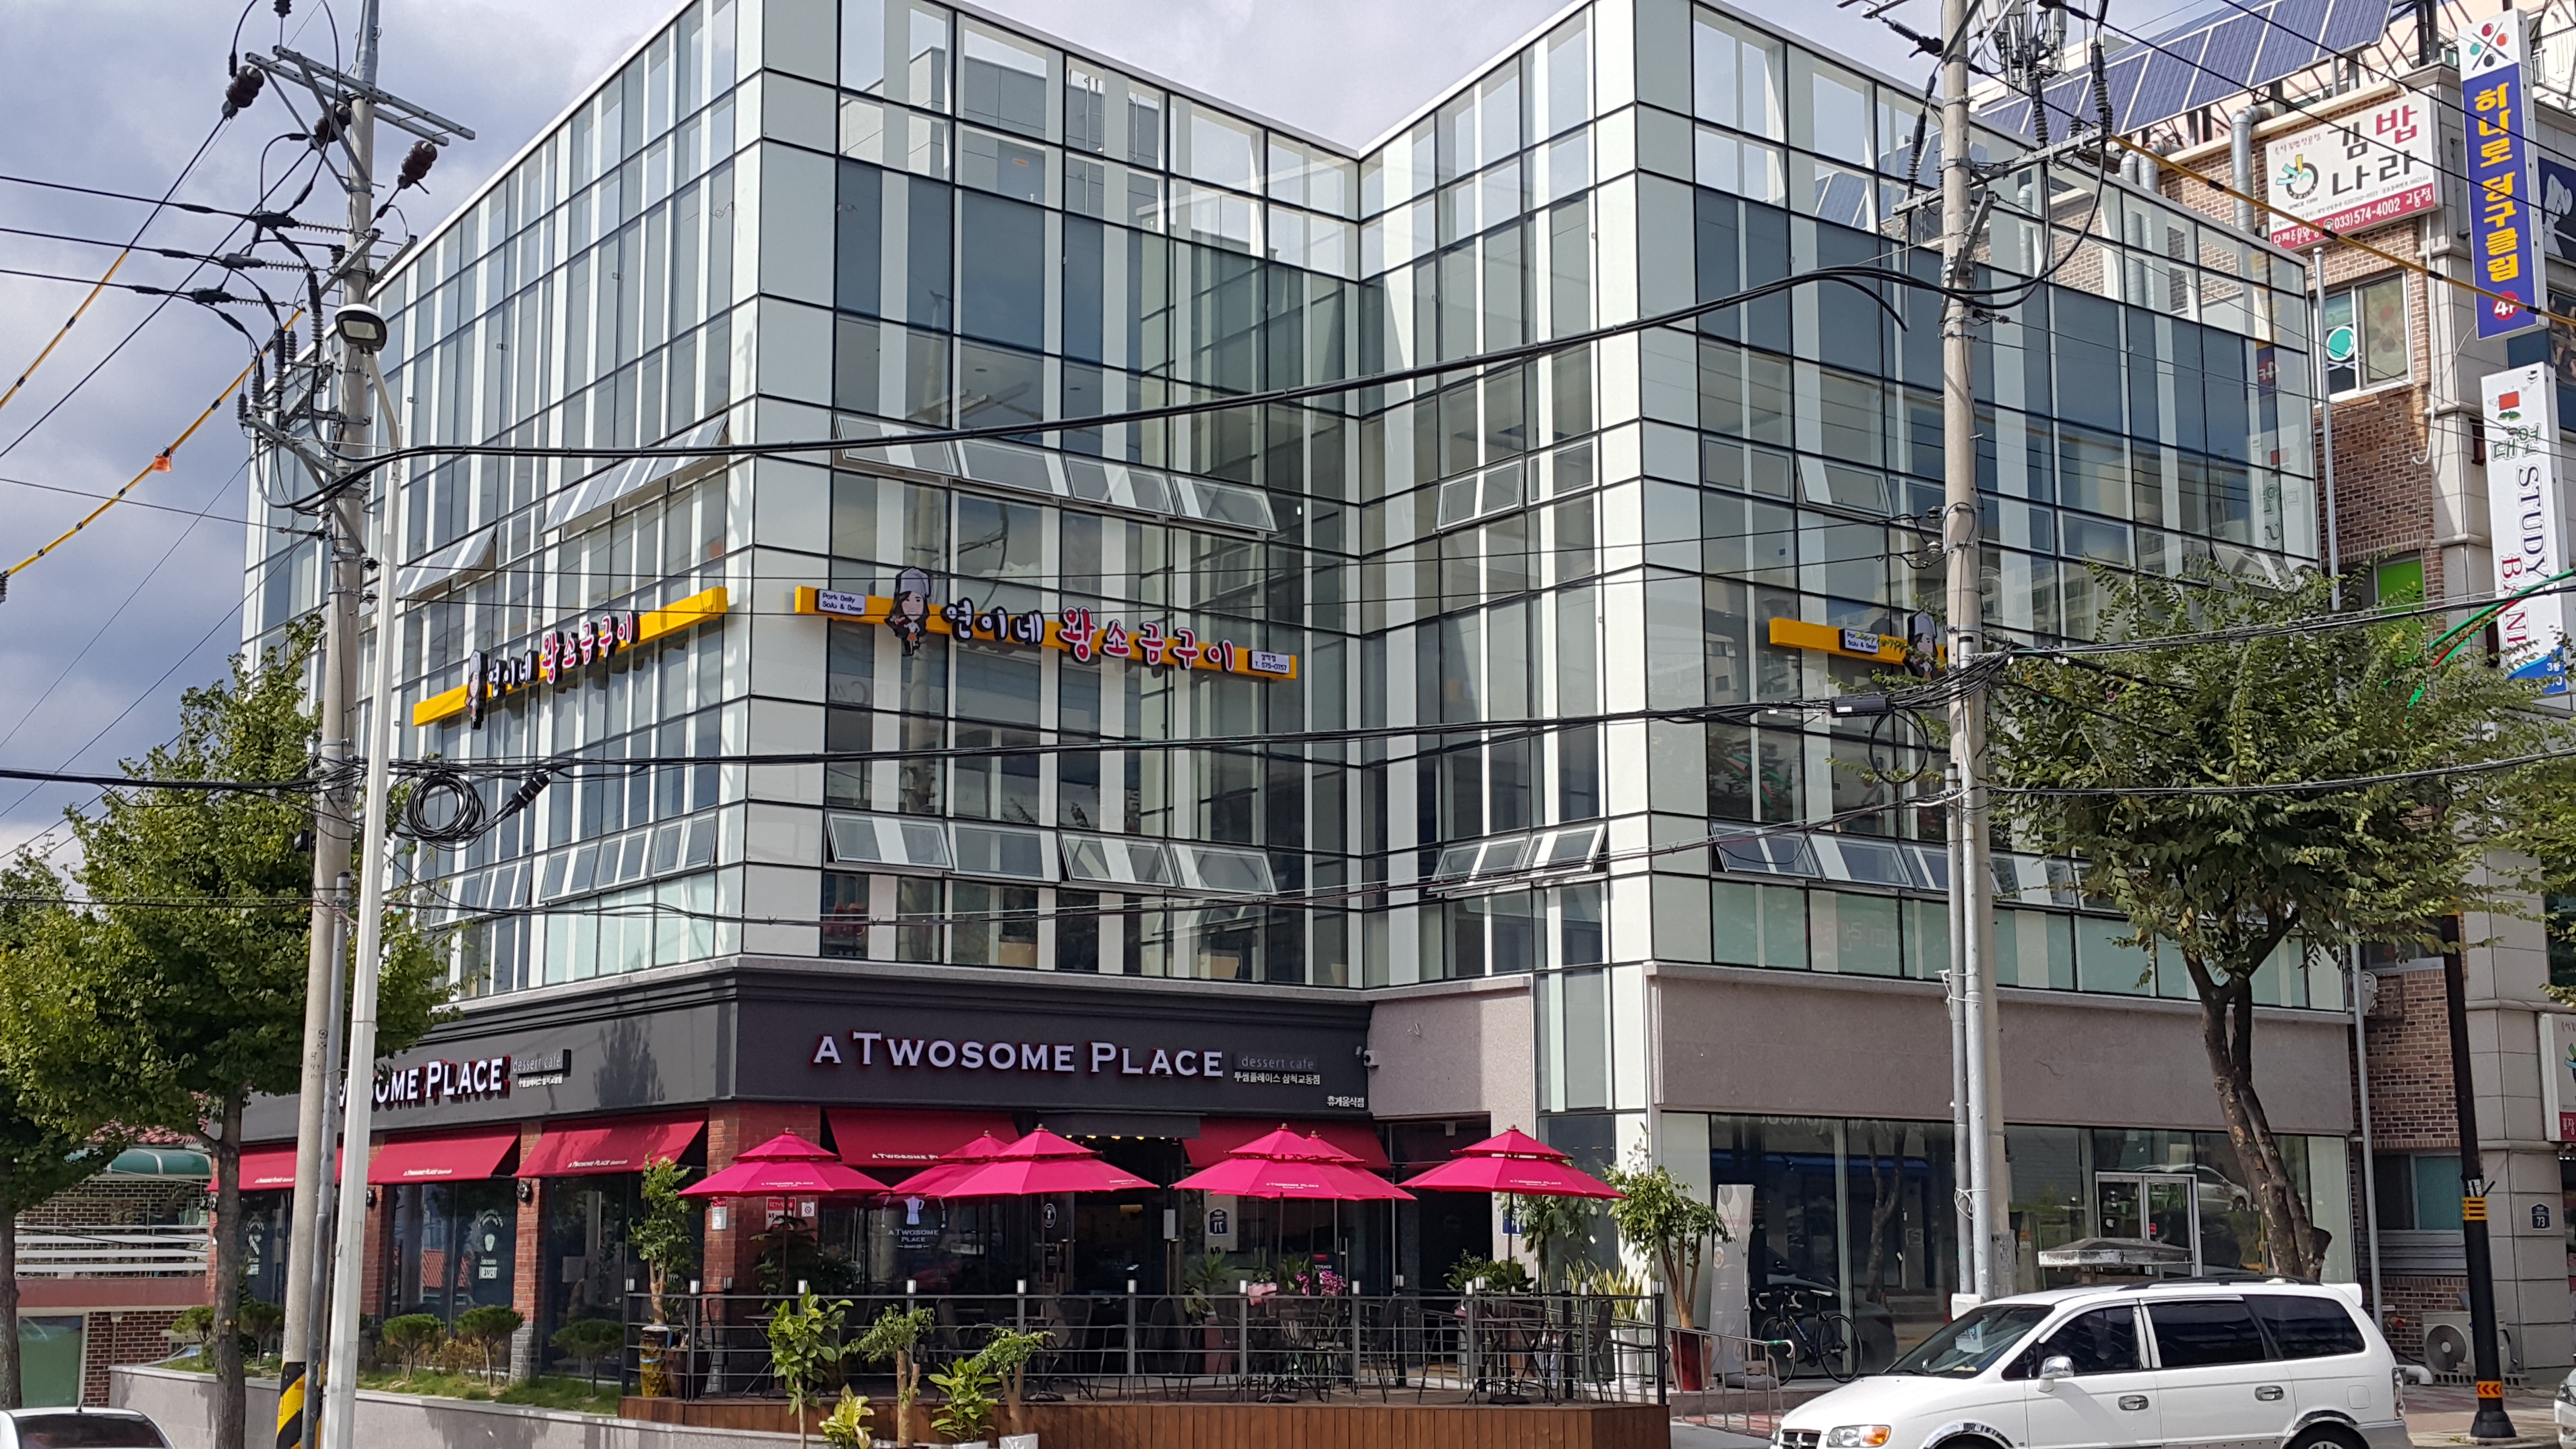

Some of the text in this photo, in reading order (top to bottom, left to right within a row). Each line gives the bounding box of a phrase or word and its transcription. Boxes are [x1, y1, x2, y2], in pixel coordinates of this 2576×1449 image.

[2327, 104, 2418, 161] 김밥
[2332, 149, 2419, 196] 나라
[2482, 171, 2520, 283] 당구클럽
[2519, 466, 2549, 579] STUDY
[487, 611, 633, 697] 연이네 왕소금구이
[942, 598, 1235, 673] 연이네 왕소금구이
[426, 1056, 504, 1099] PLACE
[813, 1031, 1224, 1078] A TWOSOME PLACE
[1234, 1071, 1320, 1085] 투썸플레이스 삼척교동점
[1241, 1056, 1314, 1069] dessert cafe
[1326, 1095, 1365, 1108] 휴게음식점
[2536, 1216, 2545, 1227] 73
